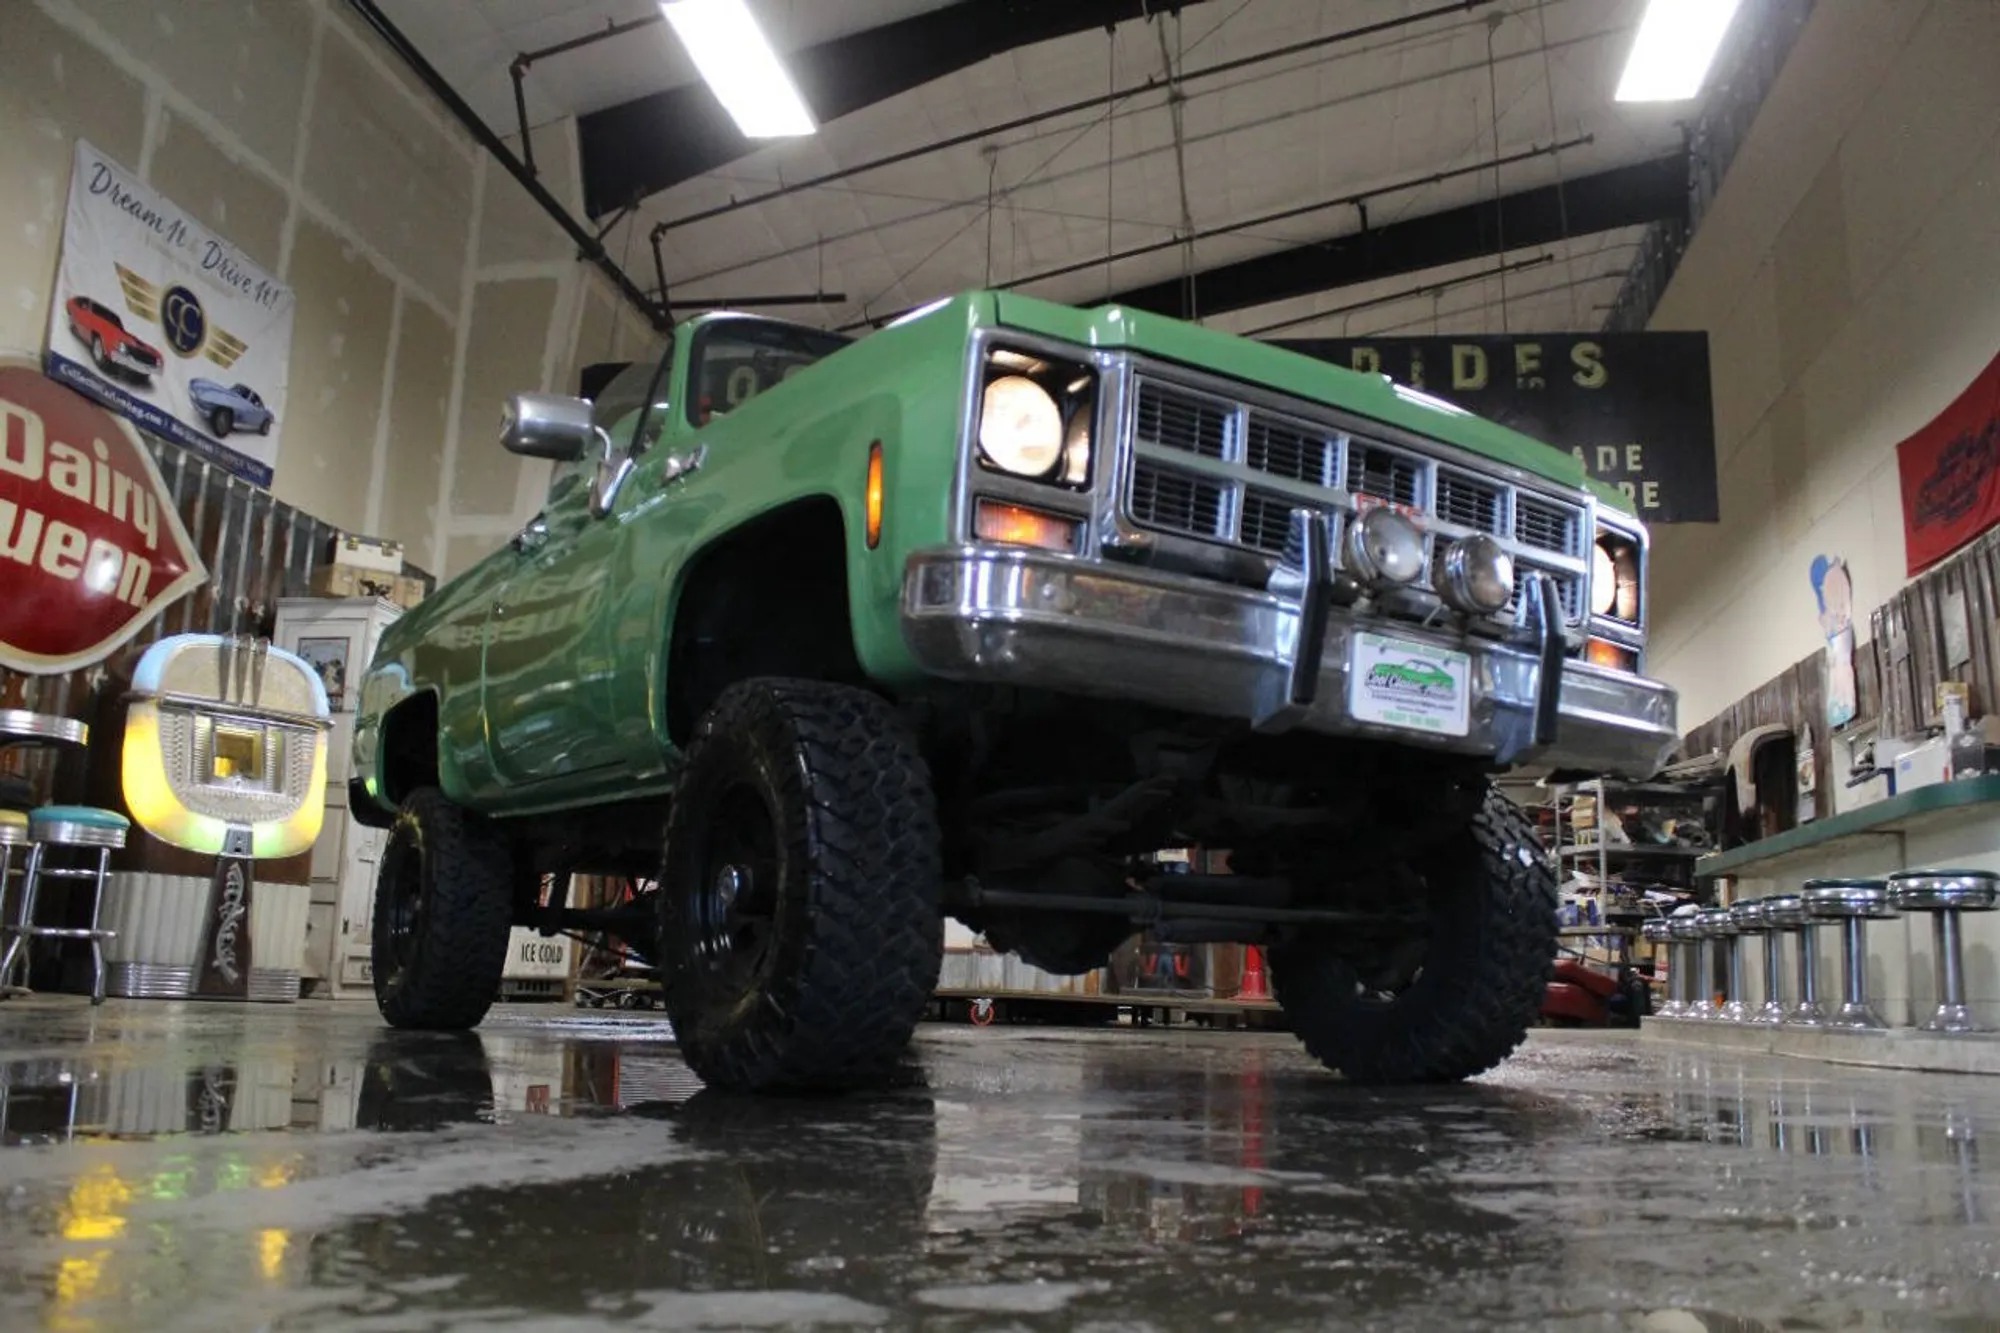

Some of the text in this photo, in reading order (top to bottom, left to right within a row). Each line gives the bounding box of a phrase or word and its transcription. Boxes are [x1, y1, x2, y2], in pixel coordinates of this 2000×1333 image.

[90, 162, 164, 234] Dream
[167, 219, 187, 247] It
[201, 240, 252, 294] Drive
[0, 398, 157, 551] Dairy
[1573, 444, 1643, 473] ADE
[0, 498, 151, 610] ueen
[521, 942, 564, 964] ICE COLD
